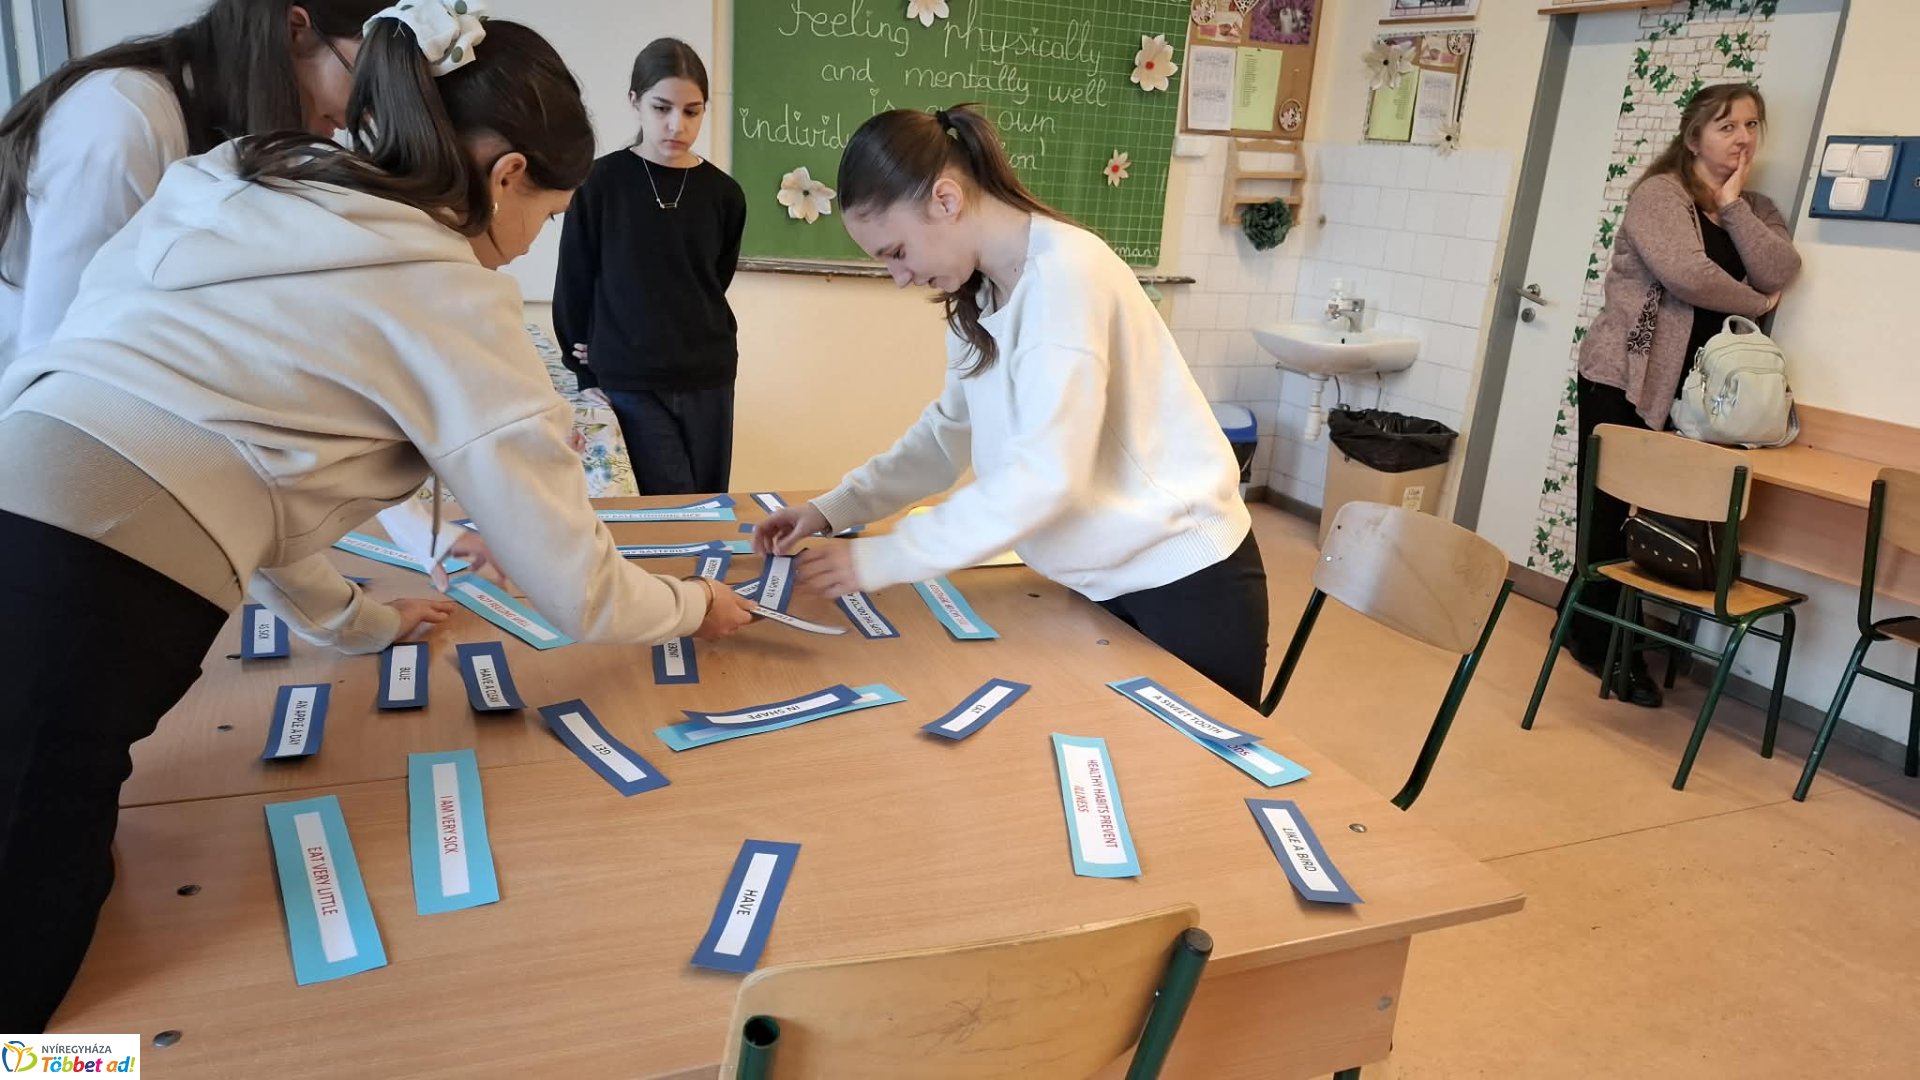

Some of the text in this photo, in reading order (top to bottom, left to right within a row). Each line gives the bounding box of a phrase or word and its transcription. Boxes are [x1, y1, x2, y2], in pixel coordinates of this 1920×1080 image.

[943, 0, 1101, 77] physically
[821, 57, 1107, 107] and mentally well
[997, 110, 1056, 134] own
[398, 667, 411, 681] BLUE
[479, 668, 494, 685] HAVE
[291, 710, 306, 728] APPLE
[747, 709, 785, 720] SHAPE
[1160, 698, 1191, 717] SWEET
[1191, 717, 1224, 734] TOOTH
[592, 744, 611, 755] GET
[440, 800, 455, 814] AM
[1074, 785, 1089, 813] ILLNESS
[1088, 759, 1118, 848] HEALTHY HABITS PREVENT
[442, 815, 458, 836] VERY
[443, 836, 459, 854] SICK
[1282, 828, 1301, 844] LIKE
[1296, 853, 1317, 872] BIRD
[307, 846, 338, 916] EAT VERY LITTLE
[736, 889, 759, 915] HAVE
